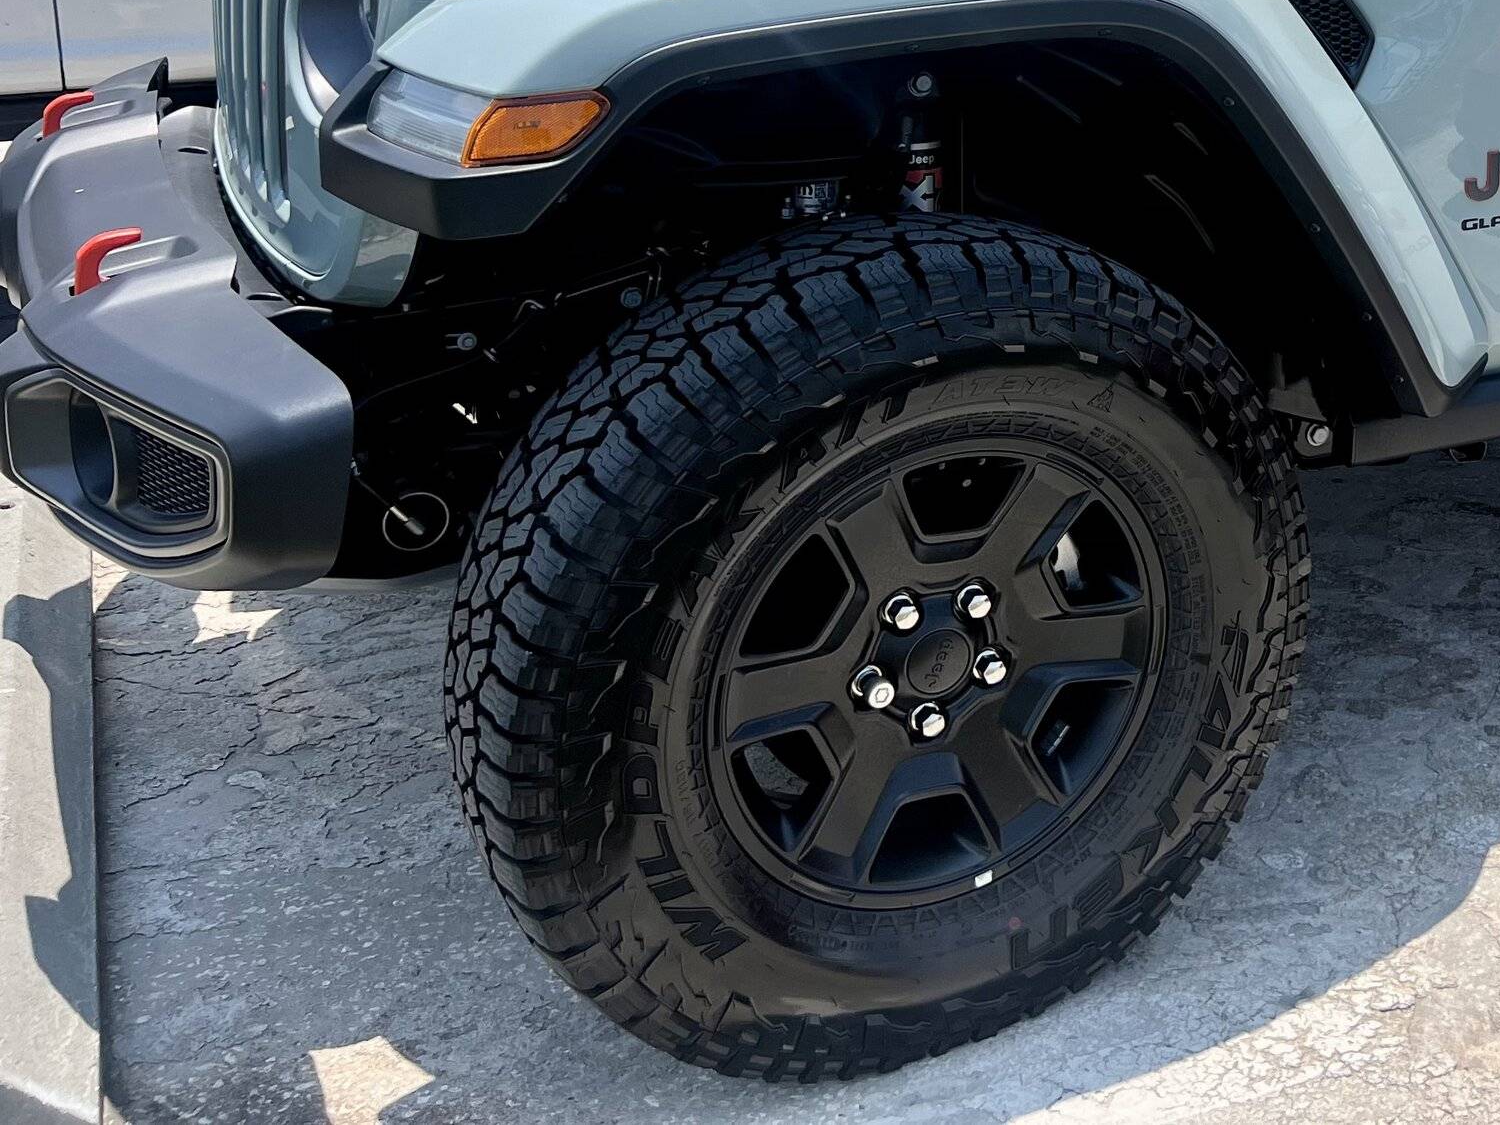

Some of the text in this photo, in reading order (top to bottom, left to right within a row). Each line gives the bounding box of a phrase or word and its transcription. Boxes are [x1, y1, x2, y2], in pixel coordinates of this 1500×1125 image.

[908, 154, 935, 165] Jeep
[621, 478, 765, 964] WILDPEAK
[923, 638, 954, 688] Jeep
[1008, 610, 1252, 971] FALKEN
